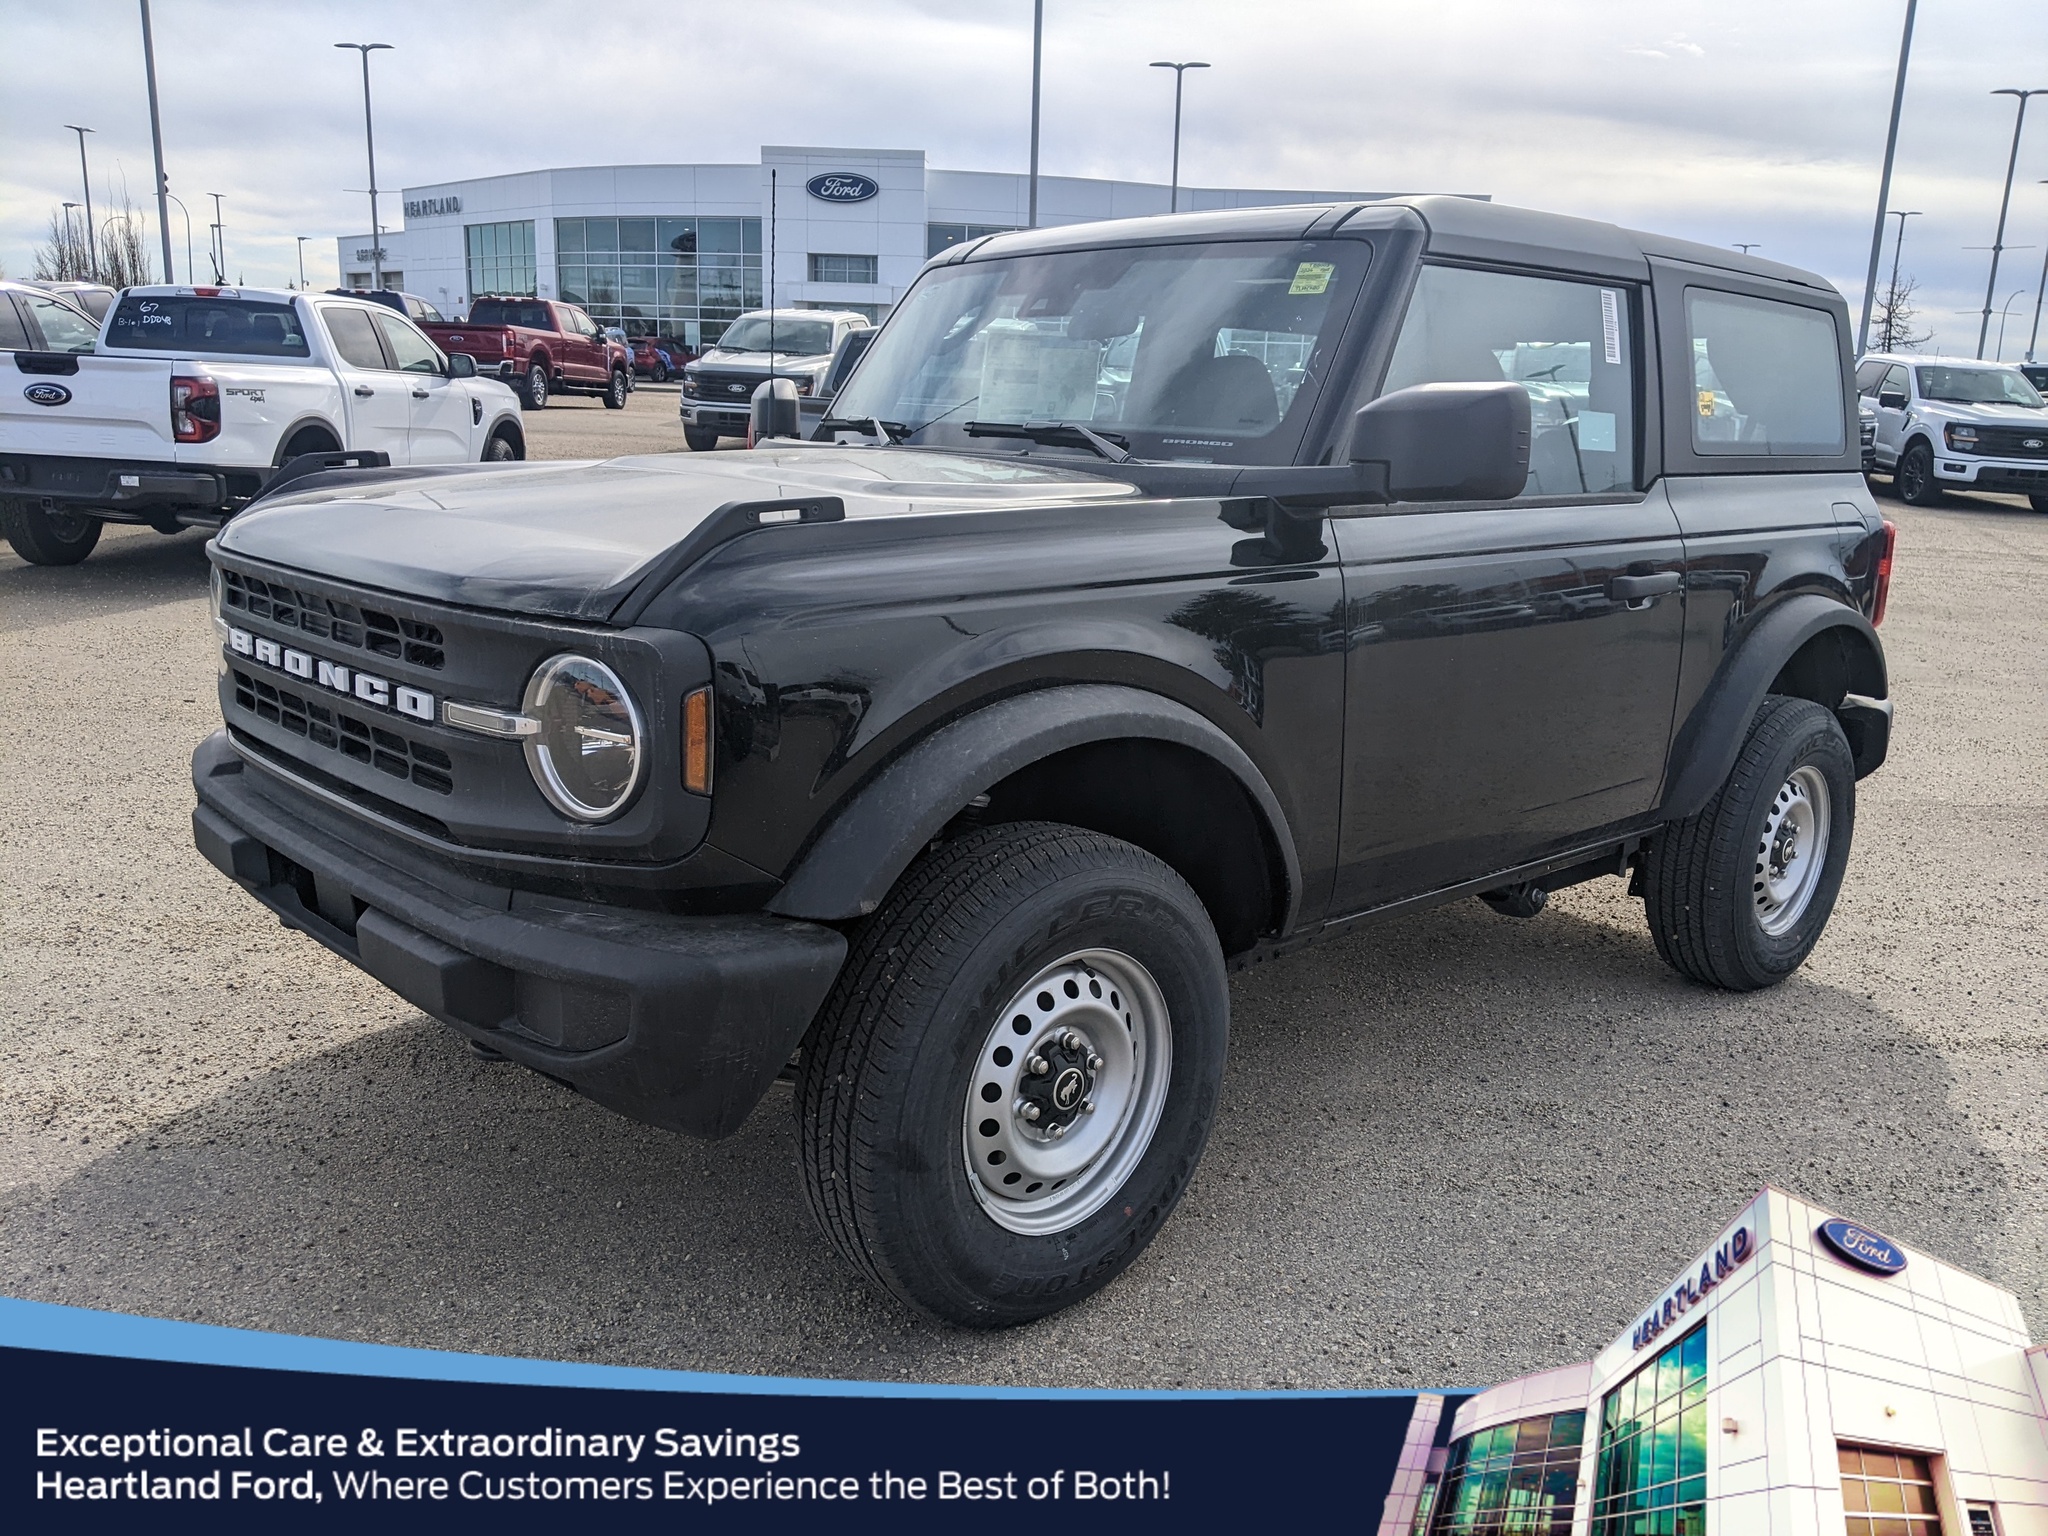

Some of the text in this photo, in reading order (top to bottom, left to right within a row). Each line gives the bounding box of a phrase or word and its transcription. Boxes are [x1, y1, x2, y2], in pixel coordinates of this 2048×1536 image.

[821, 177, 864, 196] Ford
[404, 196, 462, 217] HEARTLAND
[140, 301, 159, 313] 67
[226, 388, 266, 396] SPORT
[1162, 438, 1234, 447] BRONCO
[229, 626, 435, 721] BRONCO
